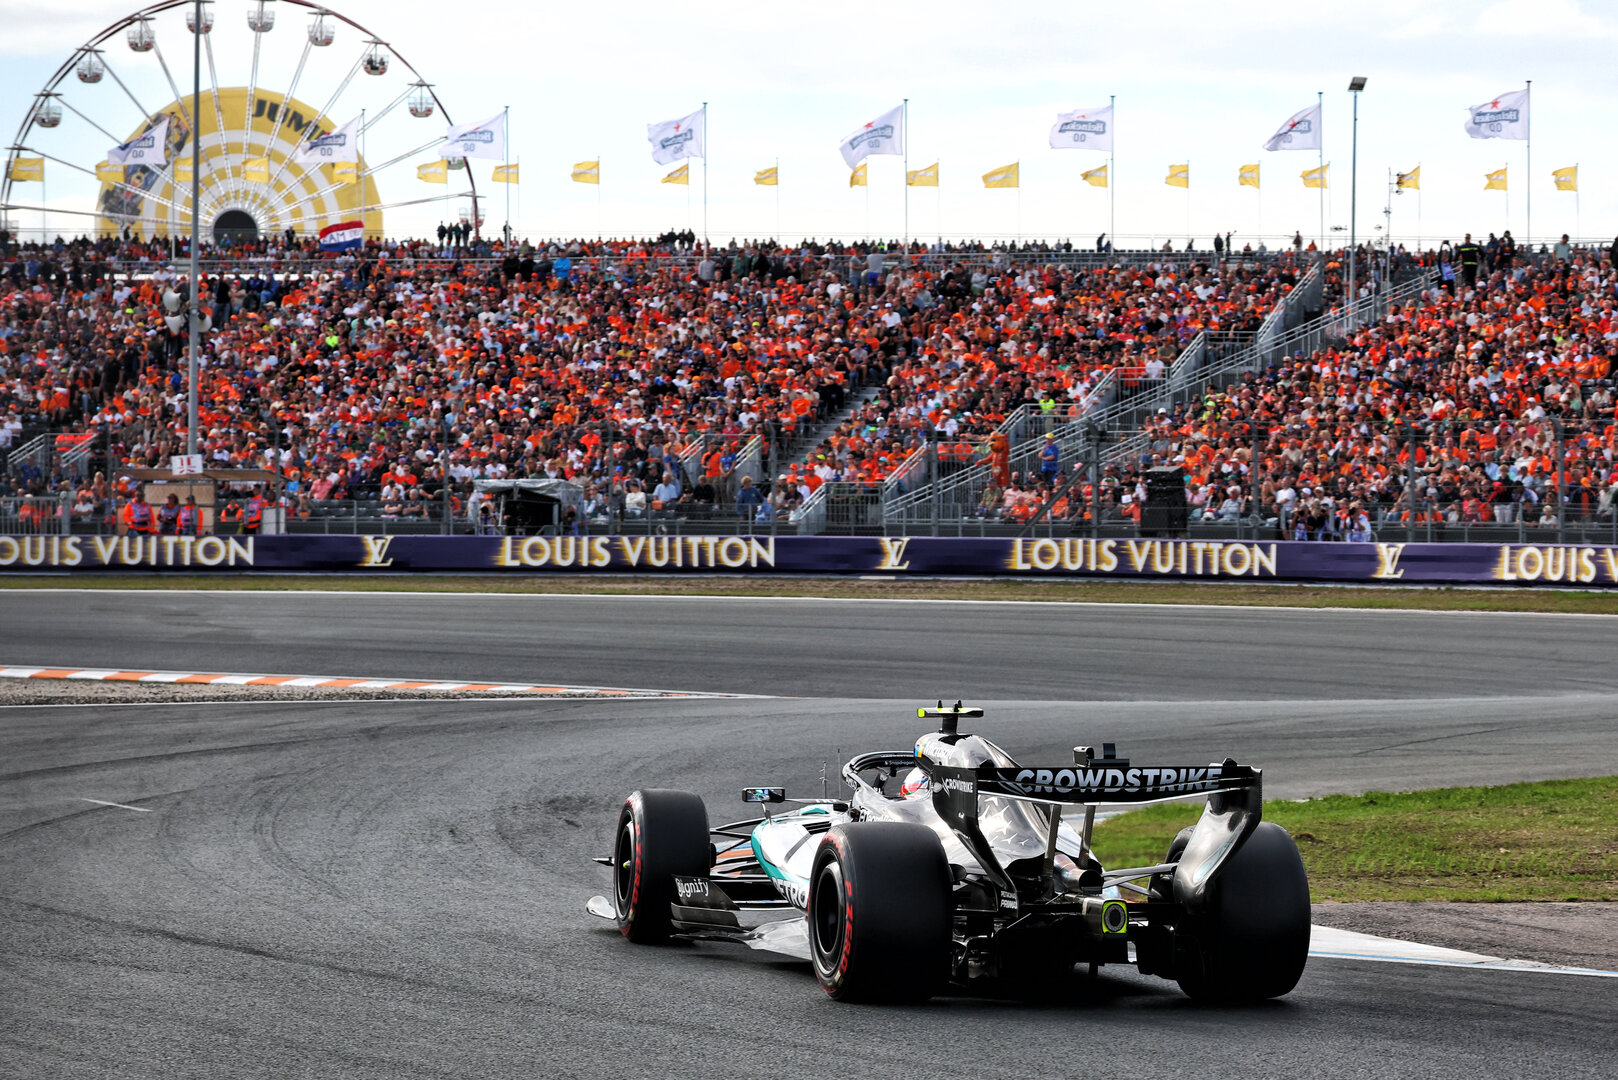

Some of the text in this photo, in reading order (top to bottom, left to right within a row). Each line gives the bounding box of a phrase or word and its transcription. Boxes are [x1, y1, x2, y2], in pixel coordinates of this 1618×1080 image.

[95, 535, 255, 566] VUITTON
[504, 536, 776, 568] LOUIS VUITTON
[1014, 538, 1277, 577] LOUIS VUITTON
[1501, 545, 1597, 583] LOUIS
[1014, 768, 1223, 795] CROWDSTRIKE
[840, 880, 854, 975] P ZERO
